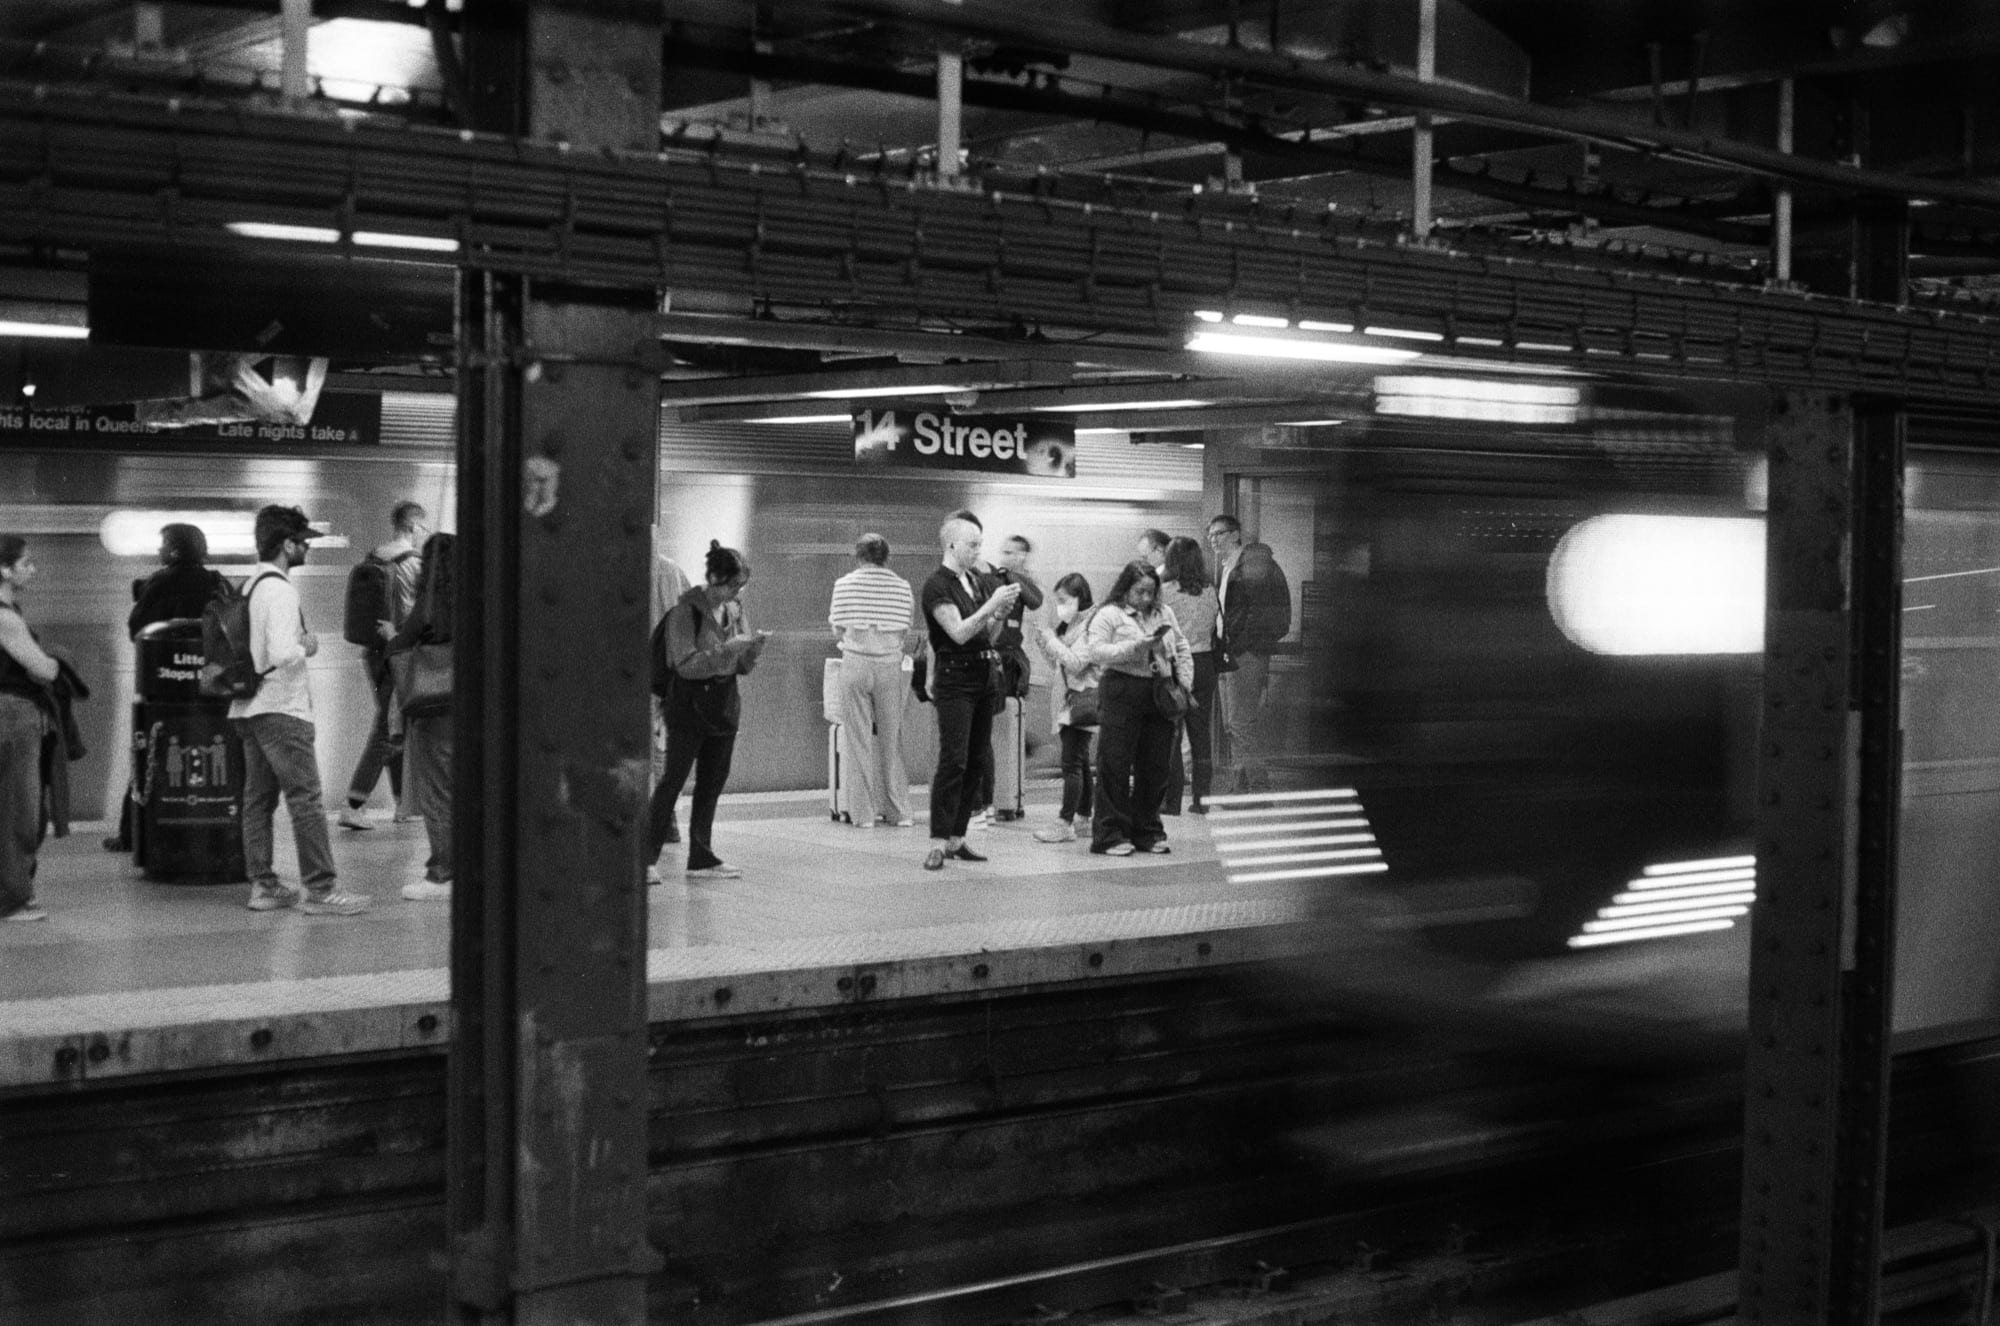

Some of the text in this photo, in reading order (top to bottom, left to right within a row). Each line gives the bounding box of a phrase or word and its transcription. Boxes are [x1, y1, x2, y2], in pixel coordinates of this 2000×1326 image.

[29, 413, 70, 431] local
[75, 415, 90, 431] in
[218, 423, 254, 437] Late
[258, 424, 306, 441] nights
[311, 425, 346, 440] take
[856, 409, 1028, 460] 14 Street
